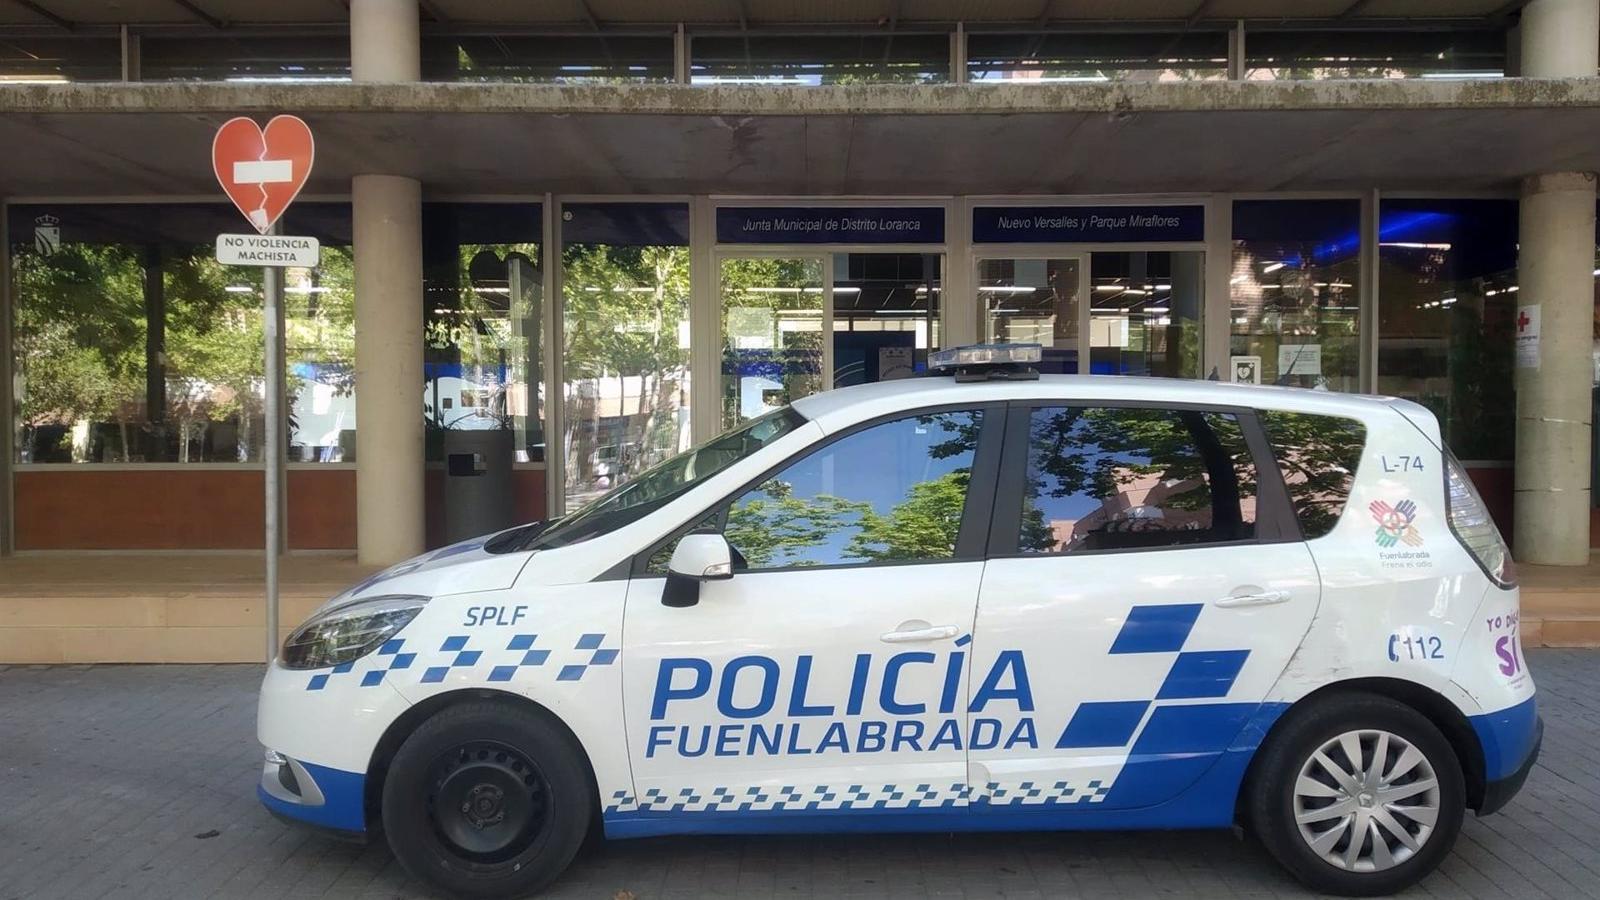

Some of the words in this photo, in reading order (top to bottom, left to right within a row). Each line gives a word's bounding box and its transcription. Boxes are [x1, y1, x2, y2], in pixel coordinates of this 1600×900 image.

[742, 218, 771, 232] Junta
[773, 218, 823, 232] Municipal
[825, 218, 838, 231] de
[841, 217, 877, 231] Distrito
[879, 218, 921, 231] Loranca
[998, 216, 1031, 229] Nuevo
[1034, 215, 1078, 228] Versalles
[1080, 219, 1087, 231] y
[1090, 215, 1126, 230] Parque
[1129, 214, 1180, 228] Miraflores
[225, 238, 244, 247] NO
[248, 238, 310, 249] VIOLENCIA
[238, 252, 297, 261] MACHISTA
[1382, 455, 1424, 473] L-74
[463, 605, 529, 626] SPLF
[1486, 616, 1502, 632] YO
[1402, 636, 1445, 661] 112
[1495, 625, 1520, 676] SÍ
[650, 633, 1036, 721] POLICÍA
[646, 717, 1039, 759] FUENLABRADA
